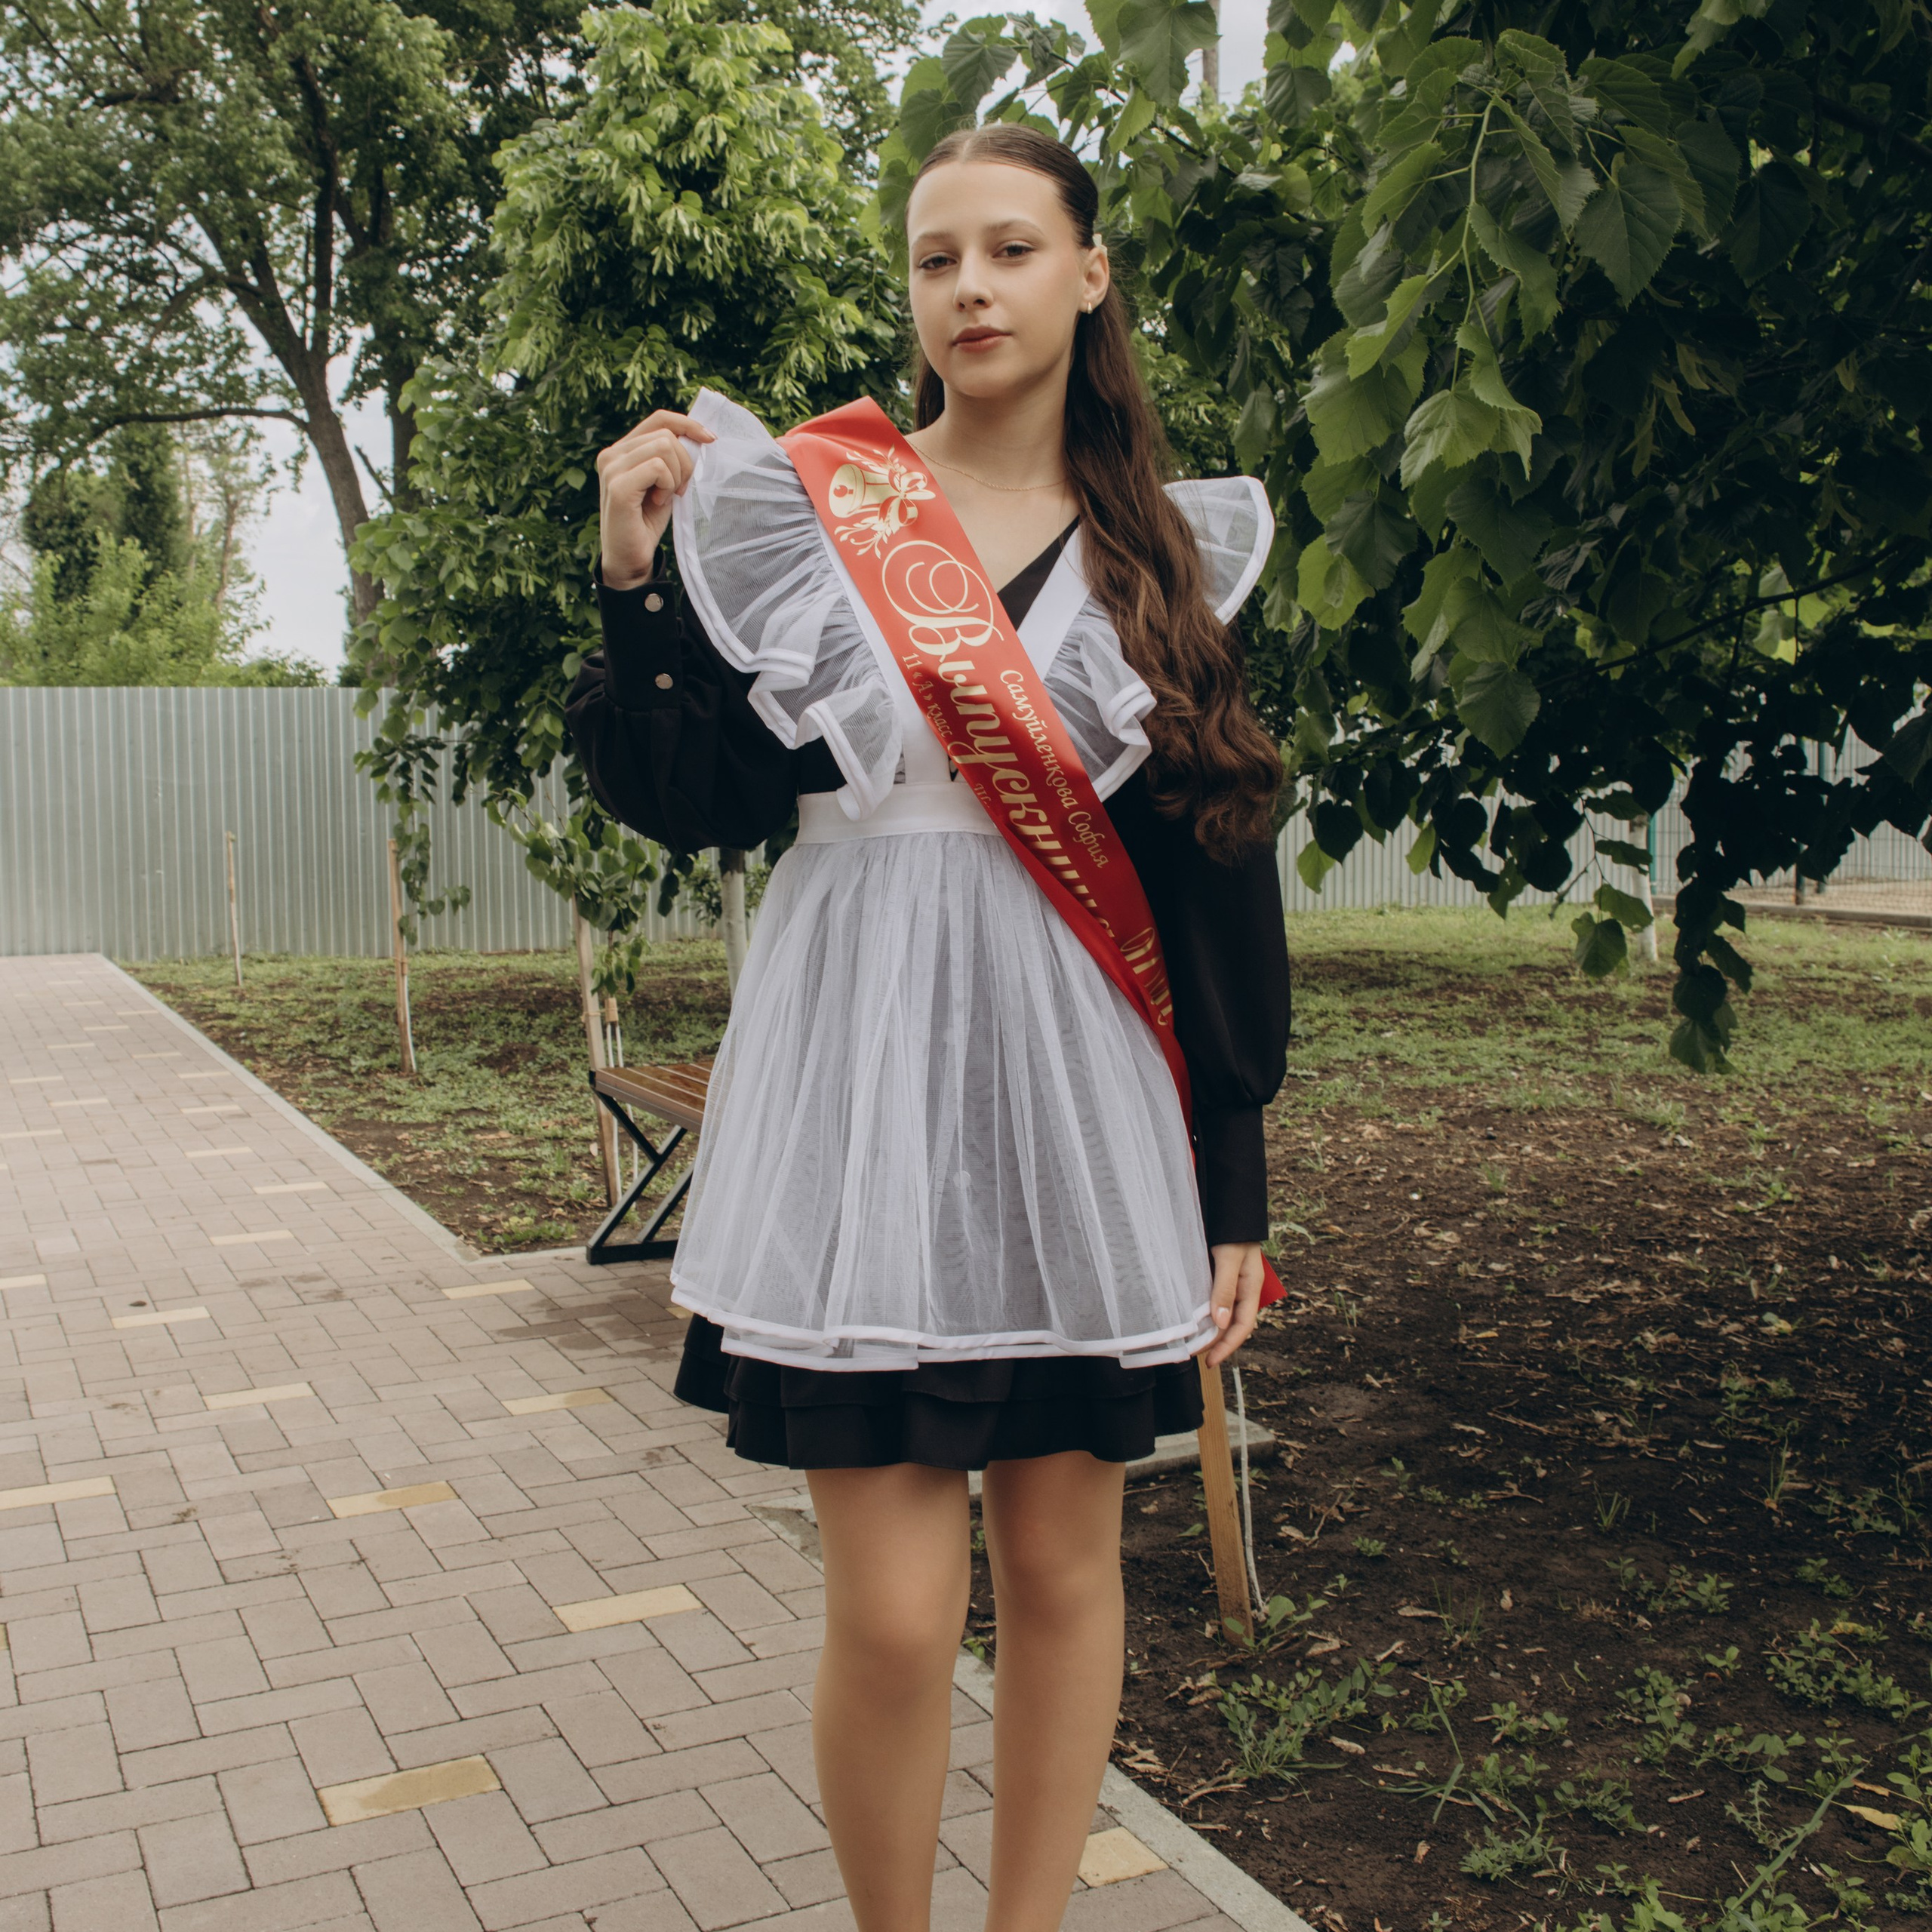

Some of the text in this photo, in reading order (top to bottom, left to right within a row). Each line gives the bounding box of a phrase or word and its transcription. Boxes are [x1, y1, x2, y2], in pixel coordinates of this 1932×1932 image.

[902, 652, 923, 670] 11
[927, 703, 953, 737] класс
[999, 669, 1109, 869] Самуйленкова София
